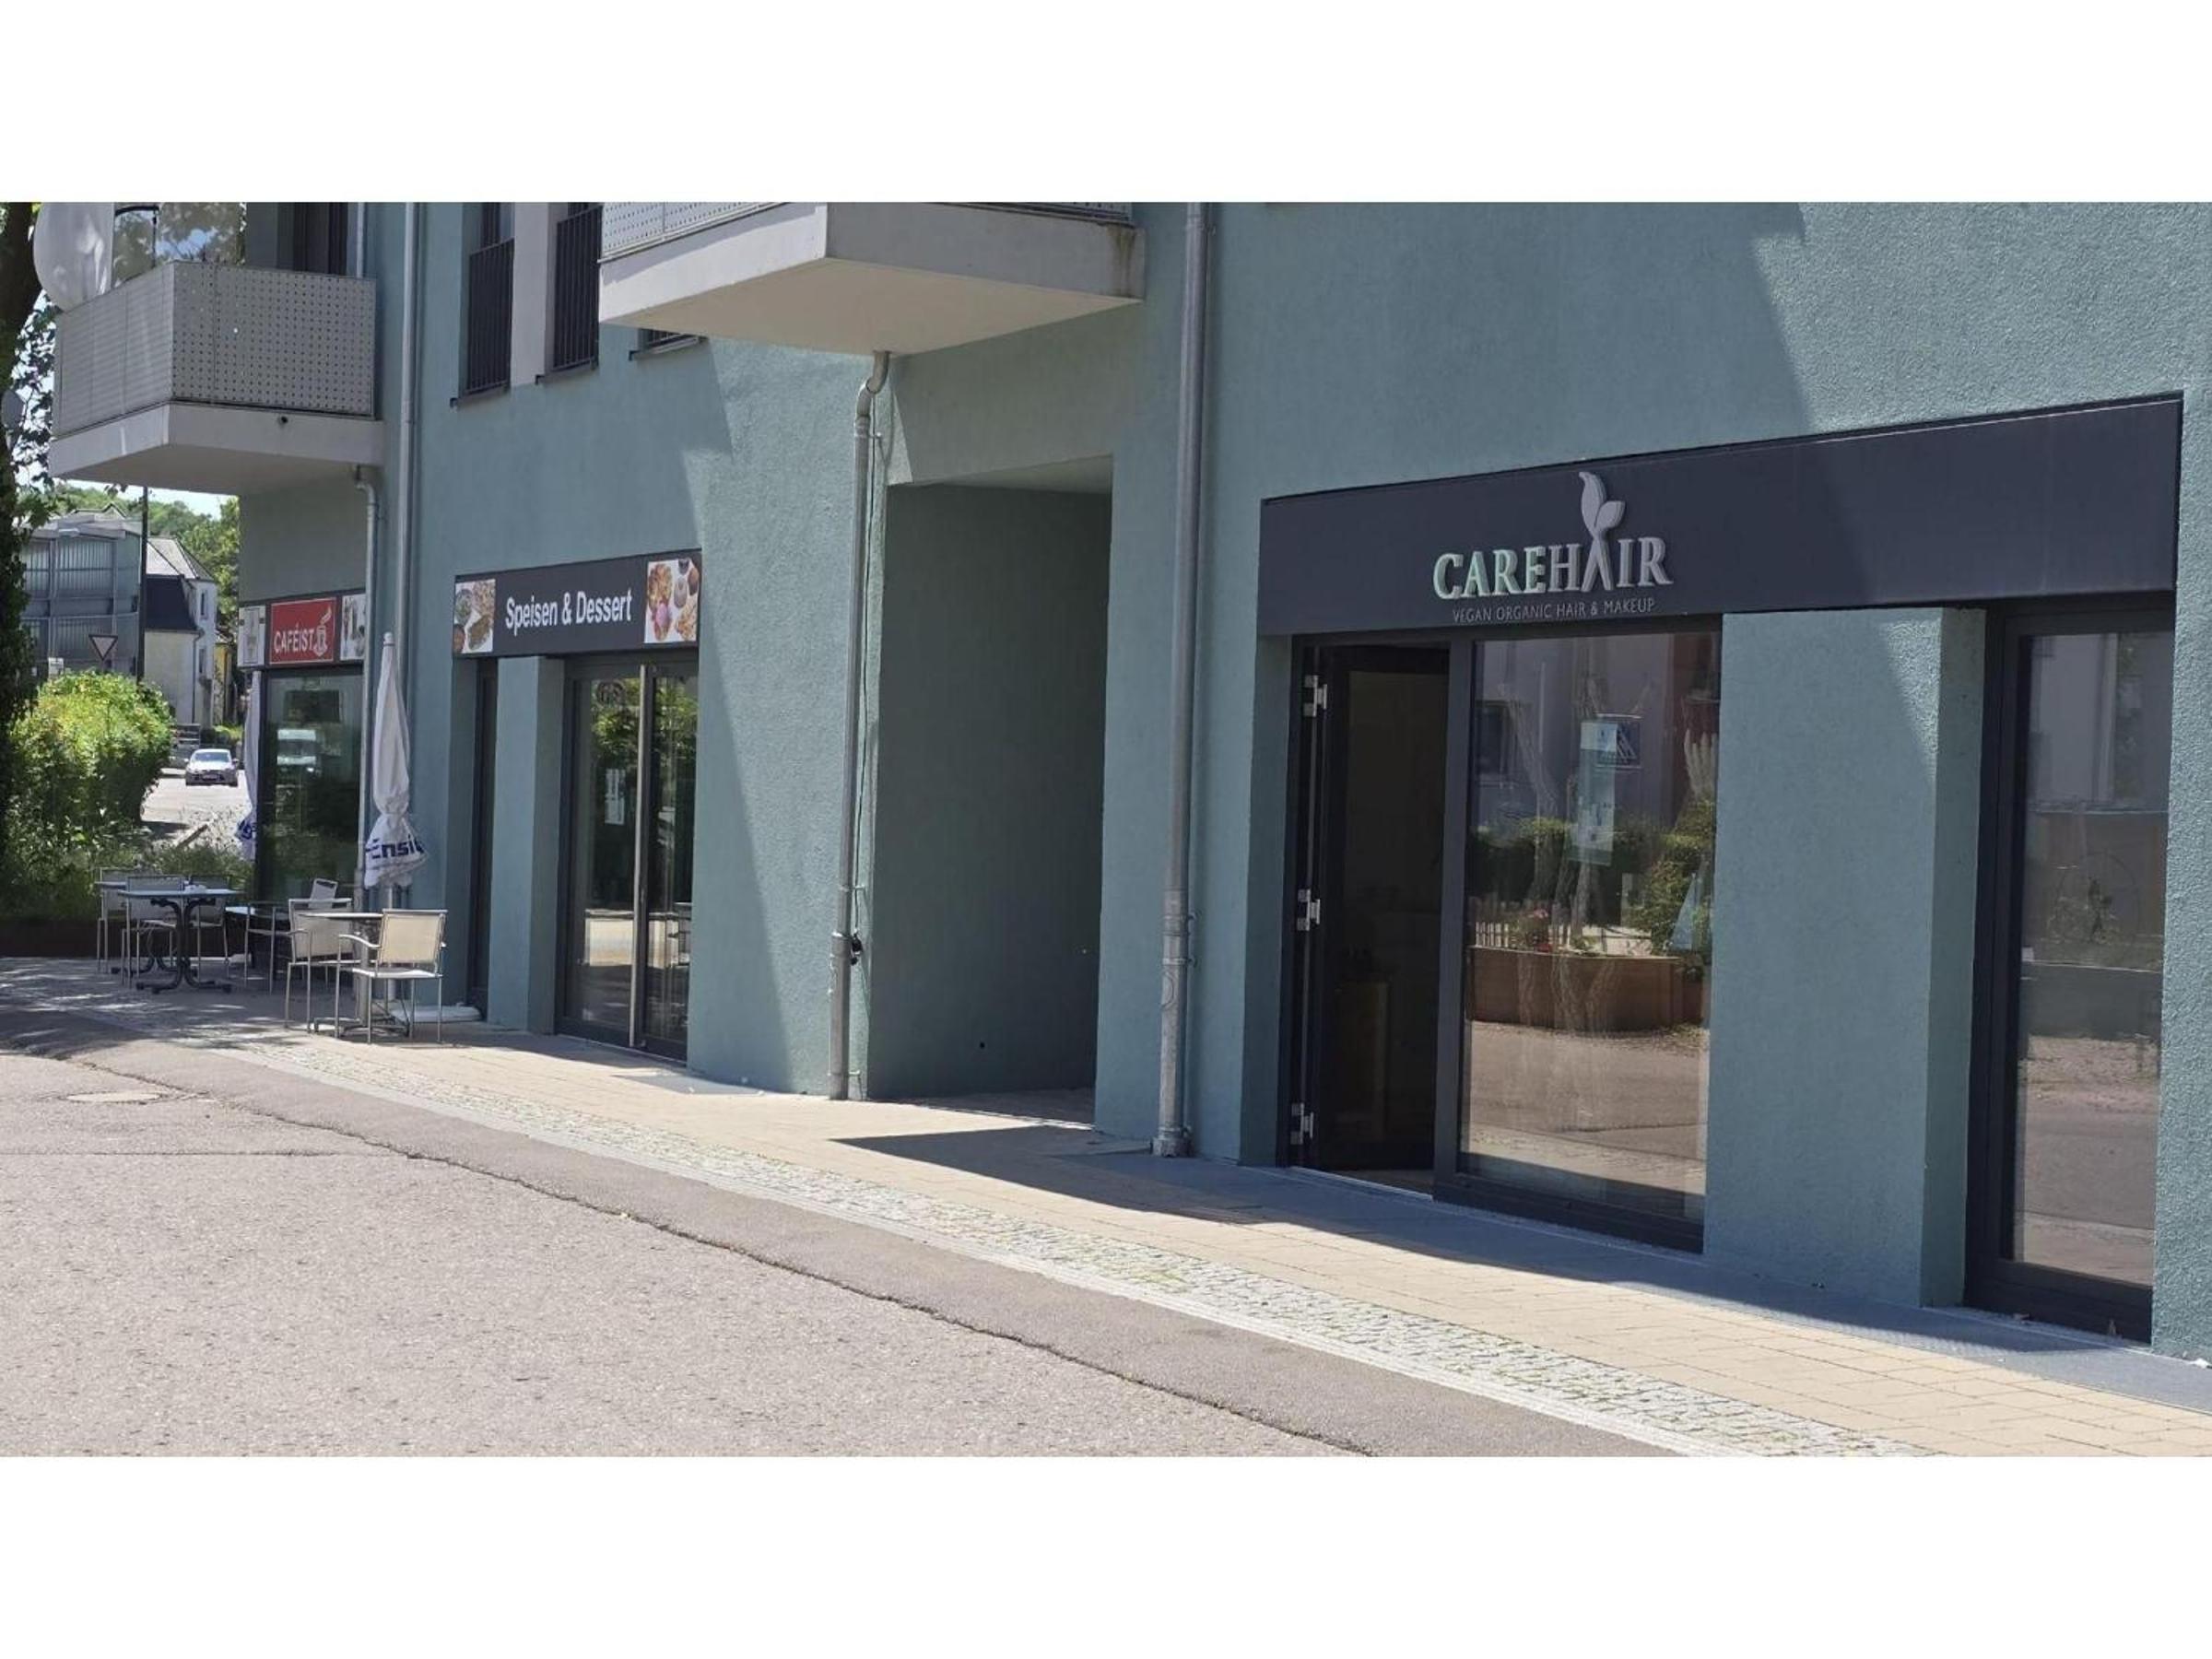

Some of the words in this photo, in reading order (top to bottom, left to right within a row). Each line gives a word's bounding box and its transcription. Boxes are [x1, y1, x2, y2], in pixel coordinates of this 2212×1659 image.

[1433, 530, 1674, 599] CAREHAIR
[506, 595, 558, 636] Speisen
[561, 592, 571, 625] &
[575, 587, 632, 624] Dessert
[1453, 608, 1491, 623] VEGAN
[1496, 604, 1552, 621] ORGANIC
[1557, 601, 1586, 618] HAIR
[1590, 601, 1598, 616] &
[1604, 598, 1655, 615] MAKEUP
